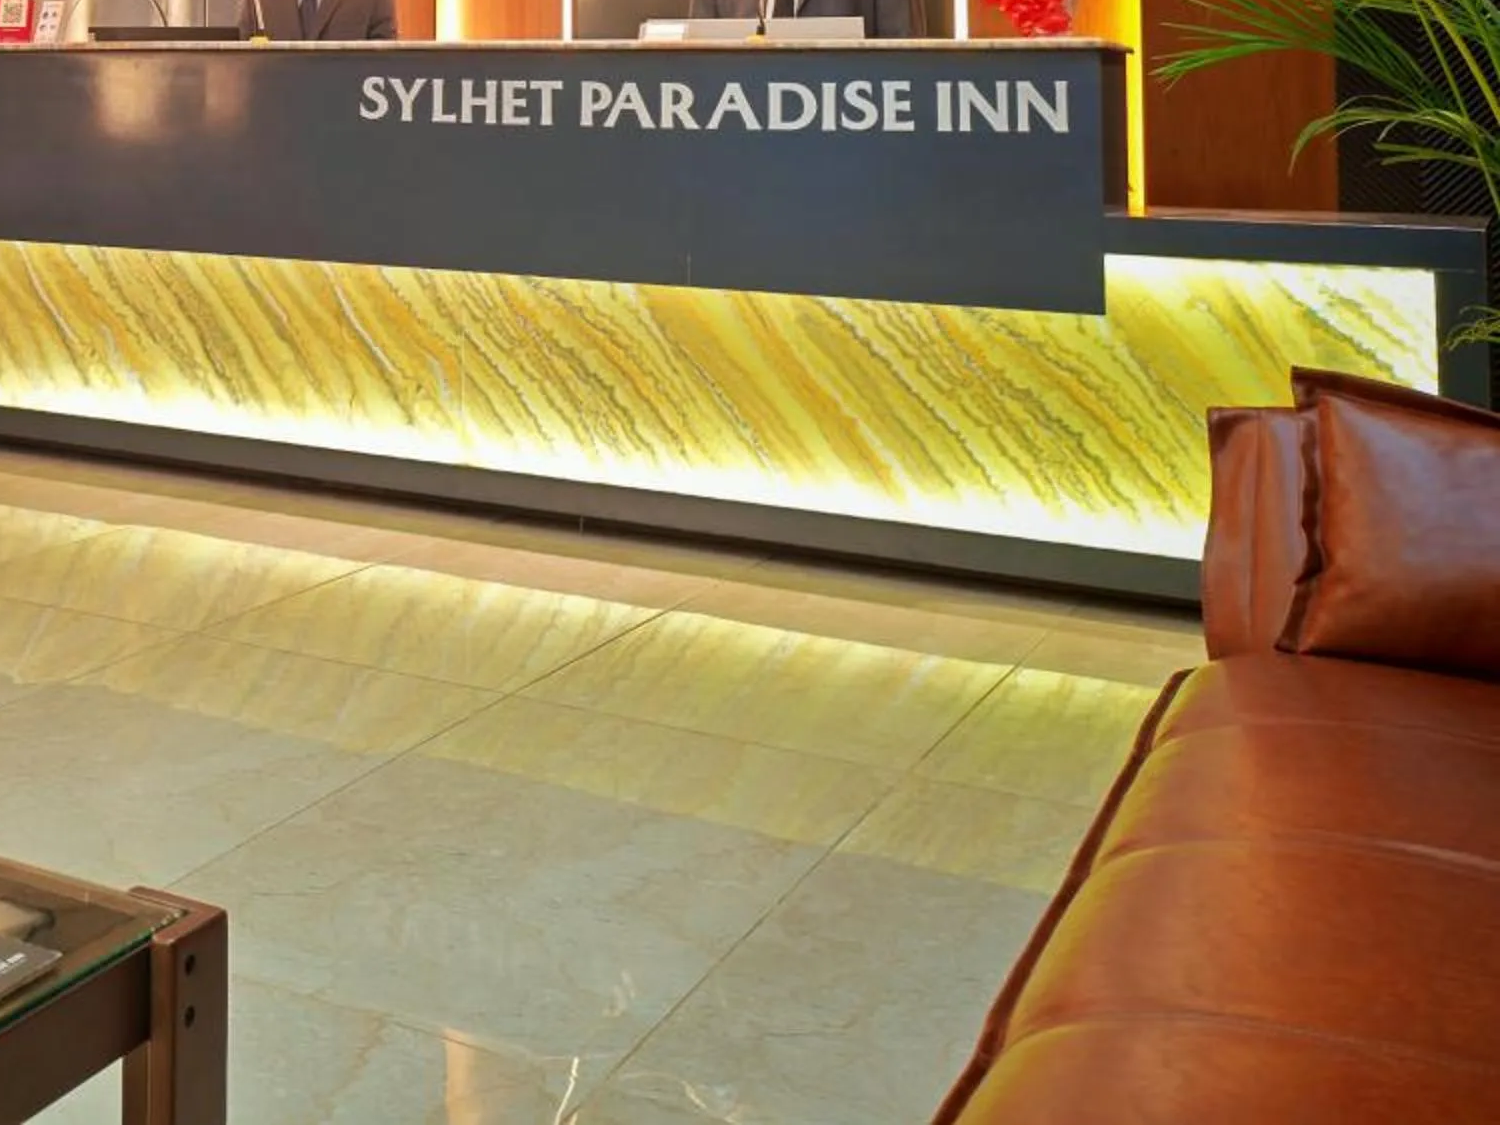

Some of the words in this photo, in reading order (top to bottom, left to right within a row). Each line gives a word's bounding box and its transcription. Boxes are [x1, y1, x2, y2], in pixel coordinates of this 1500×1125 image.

[360, 77, 563, 125] SYLHET
[579, 80, 916, 131] PARADISE
[935, 81, 1069, 132] INN
